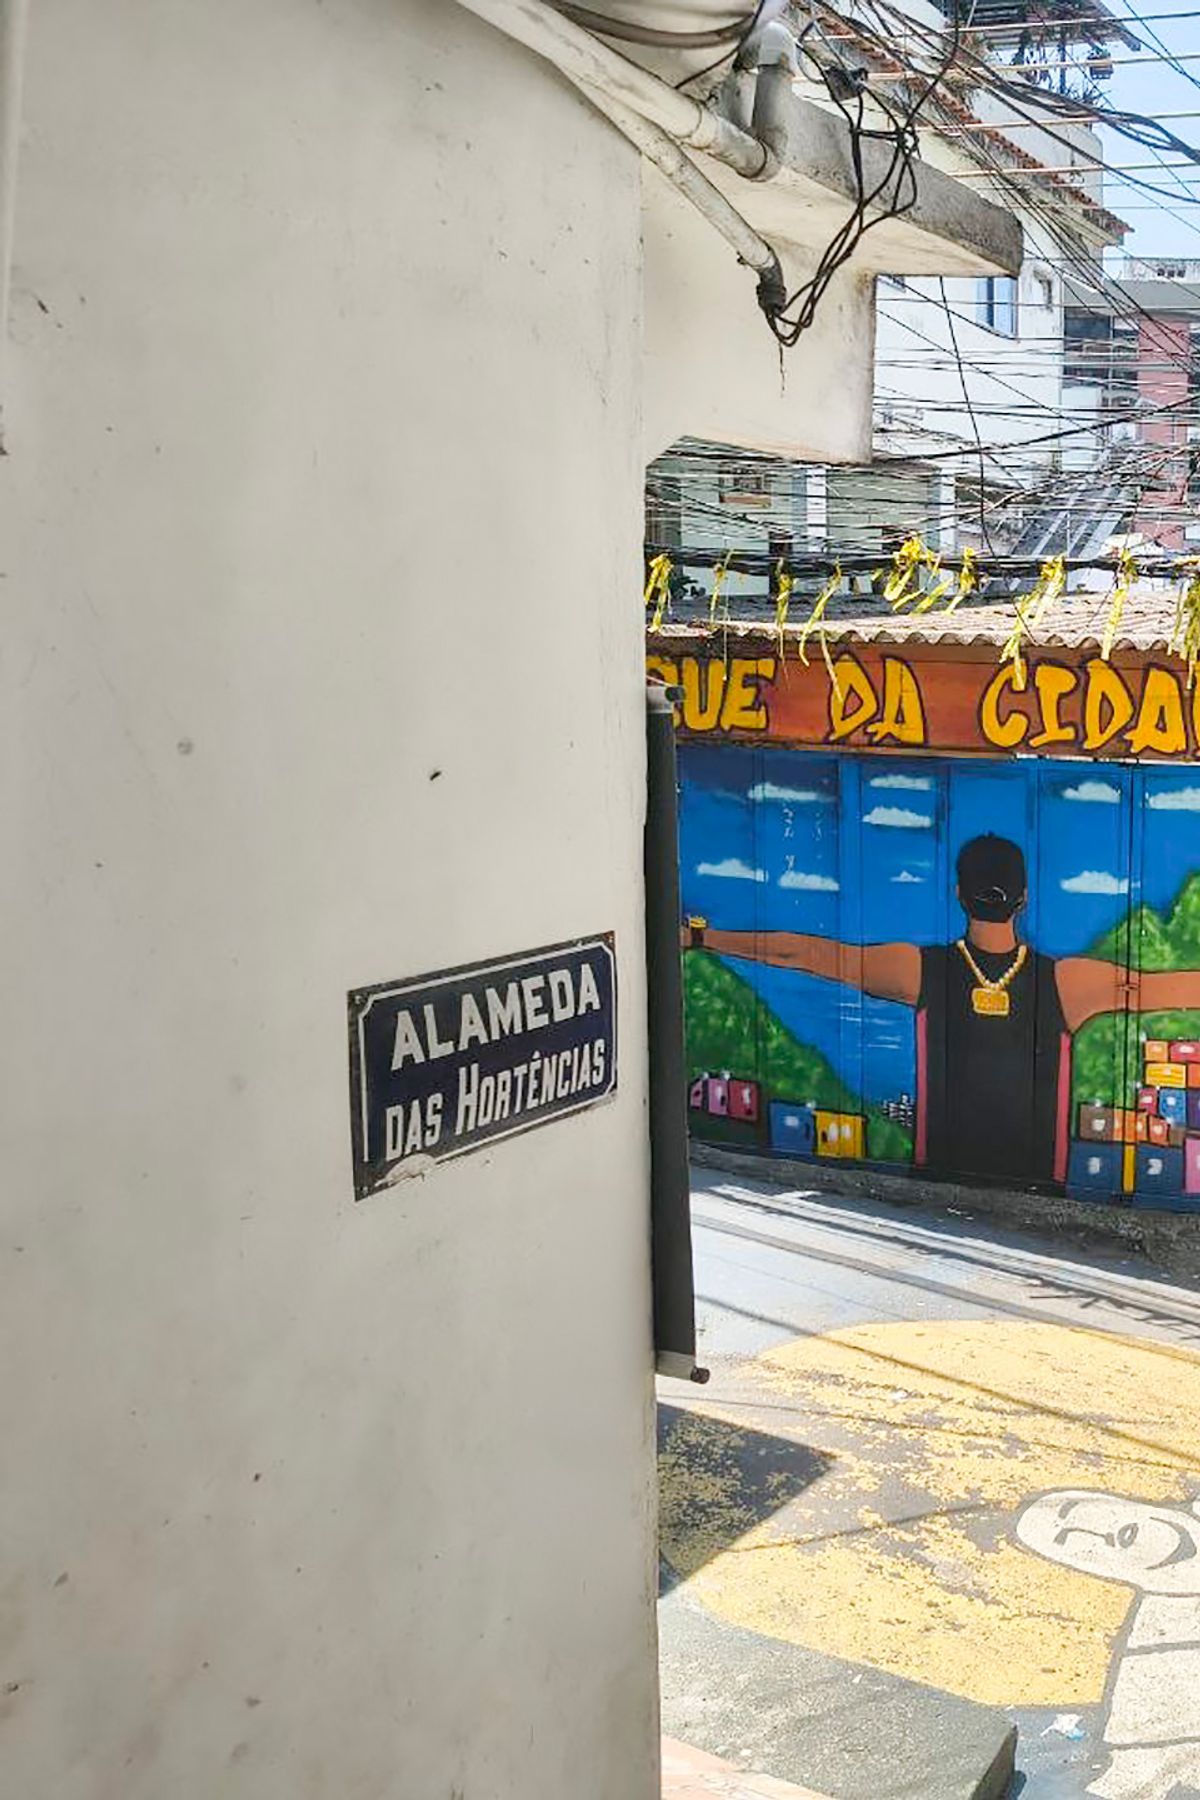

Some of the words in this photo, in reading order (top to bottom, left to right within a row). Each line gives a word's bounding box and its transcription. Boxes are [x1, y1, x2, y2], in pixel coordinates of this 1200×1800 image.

[829, 655, 924, 745] DA
[391, 963, 600, 1071] ALAMEDA
[385, 1093, 443, 1161] DAS
